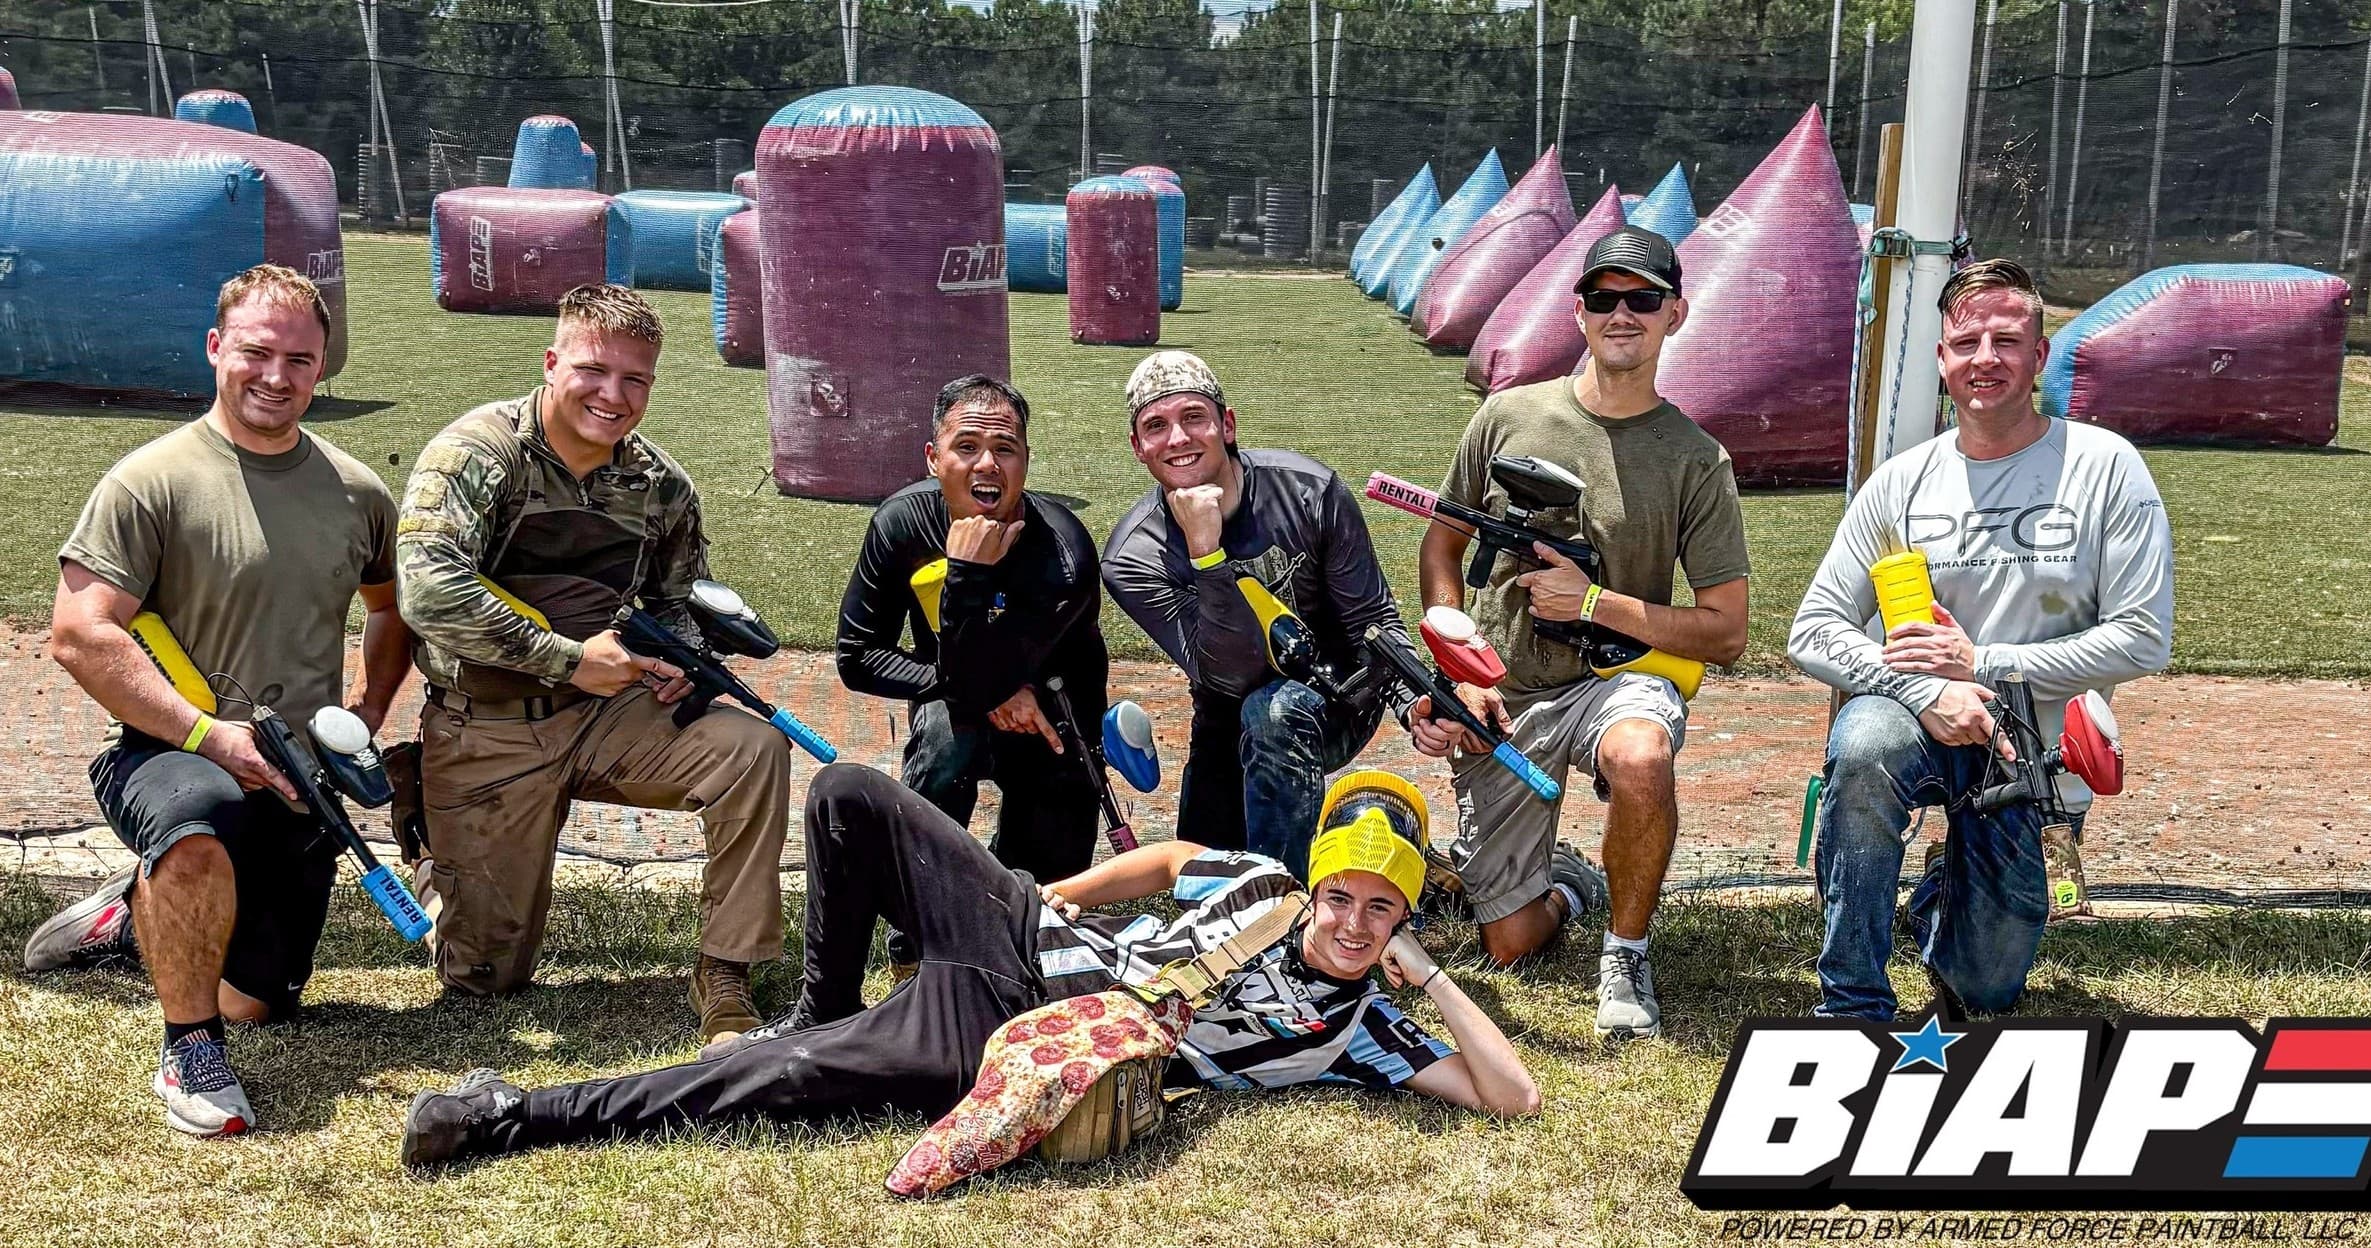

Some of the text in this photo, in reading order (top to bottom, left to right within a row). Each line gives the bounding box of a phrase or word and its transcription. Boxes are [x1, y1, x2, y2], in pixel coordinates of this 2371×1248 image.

[1378, 480, 1427, 509] RENTAL
[1906, 503, 2079, 557] PFG
[1990, 555, 2039, 566] FSHING
[2043, 555, 2078, 564] GEAR
[379, 874, 422, 924] RENTAL
